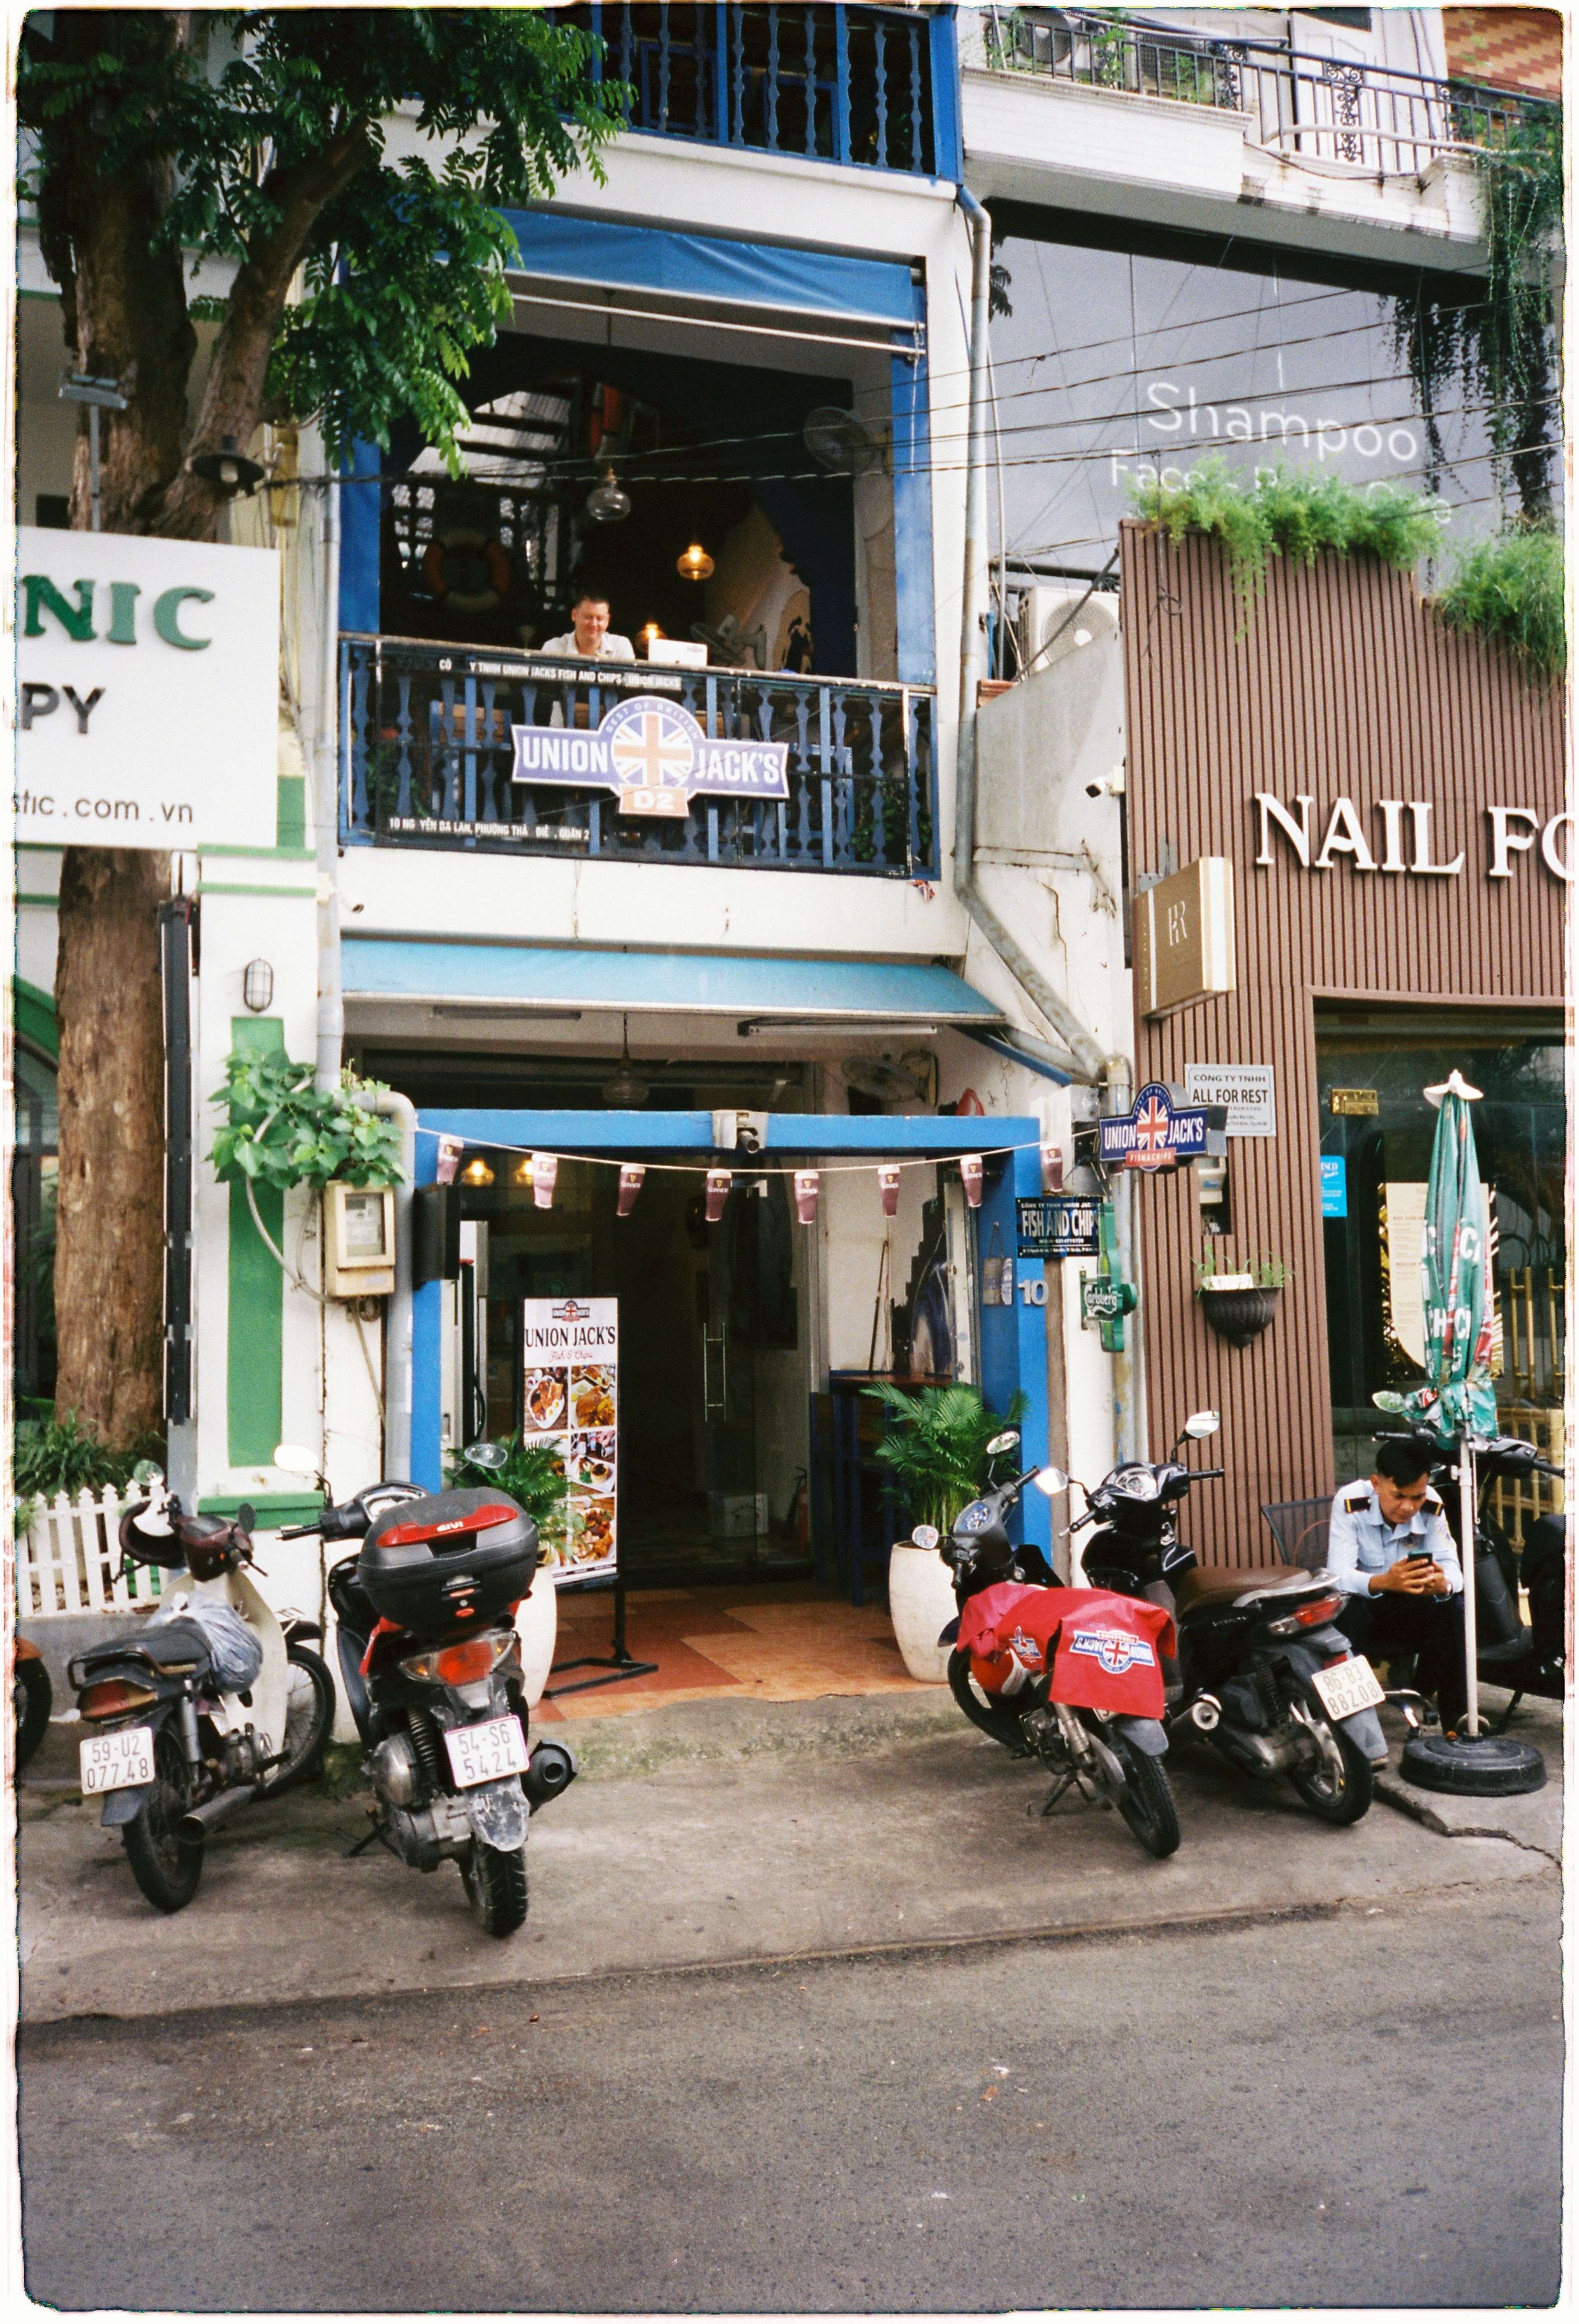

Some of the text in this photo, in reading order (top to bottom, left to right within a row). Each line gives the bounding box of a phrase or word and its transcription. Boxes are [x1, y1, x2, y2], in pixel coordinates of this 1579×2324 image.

[1147, 382, 1417, 461] Shampoo
[22, 574, 215, 651] NIC
[502, 664, 529, 677] UNION
[530, 666, 556, 679] JACKS
[557, 668, 576, 682] FISH
[578, 670, 596, 683] AND
[597, 672, 622, 685] CHIPS
[21, 683, 106, 734] PY
[605, 701, 699, 739] BEST OF BRITISH
[522, 737, 780, 784] UNION JACK'S
[634, 793, 674, 810] D2
[389, 817, 400, 829] 10
[584, 829, 590, 840] 2
[1254, 793, 1465, 874] NAIL
[1194, 1074, 1222, 1082] CÔNG
[1193, 1089, 1268, 1103] ALL FOR REST
[1104, 1117, 1204, 1150] UNION JACK'S
[1022, 1209, 1044, 1237] FISH
[1046, 1210, 1070, 1237] AND
[1018, 1279, 1049, 1305] 10
[1084, 1284, 1118, 1312] Carlsberg
[526, 1326, 616, 1347] UNION JACK'S
[436, 1520, 464, 1532] GIVI
[87, 1757, 149, 1789] 077.48
[463, 1747, 517, 1779] 5424
